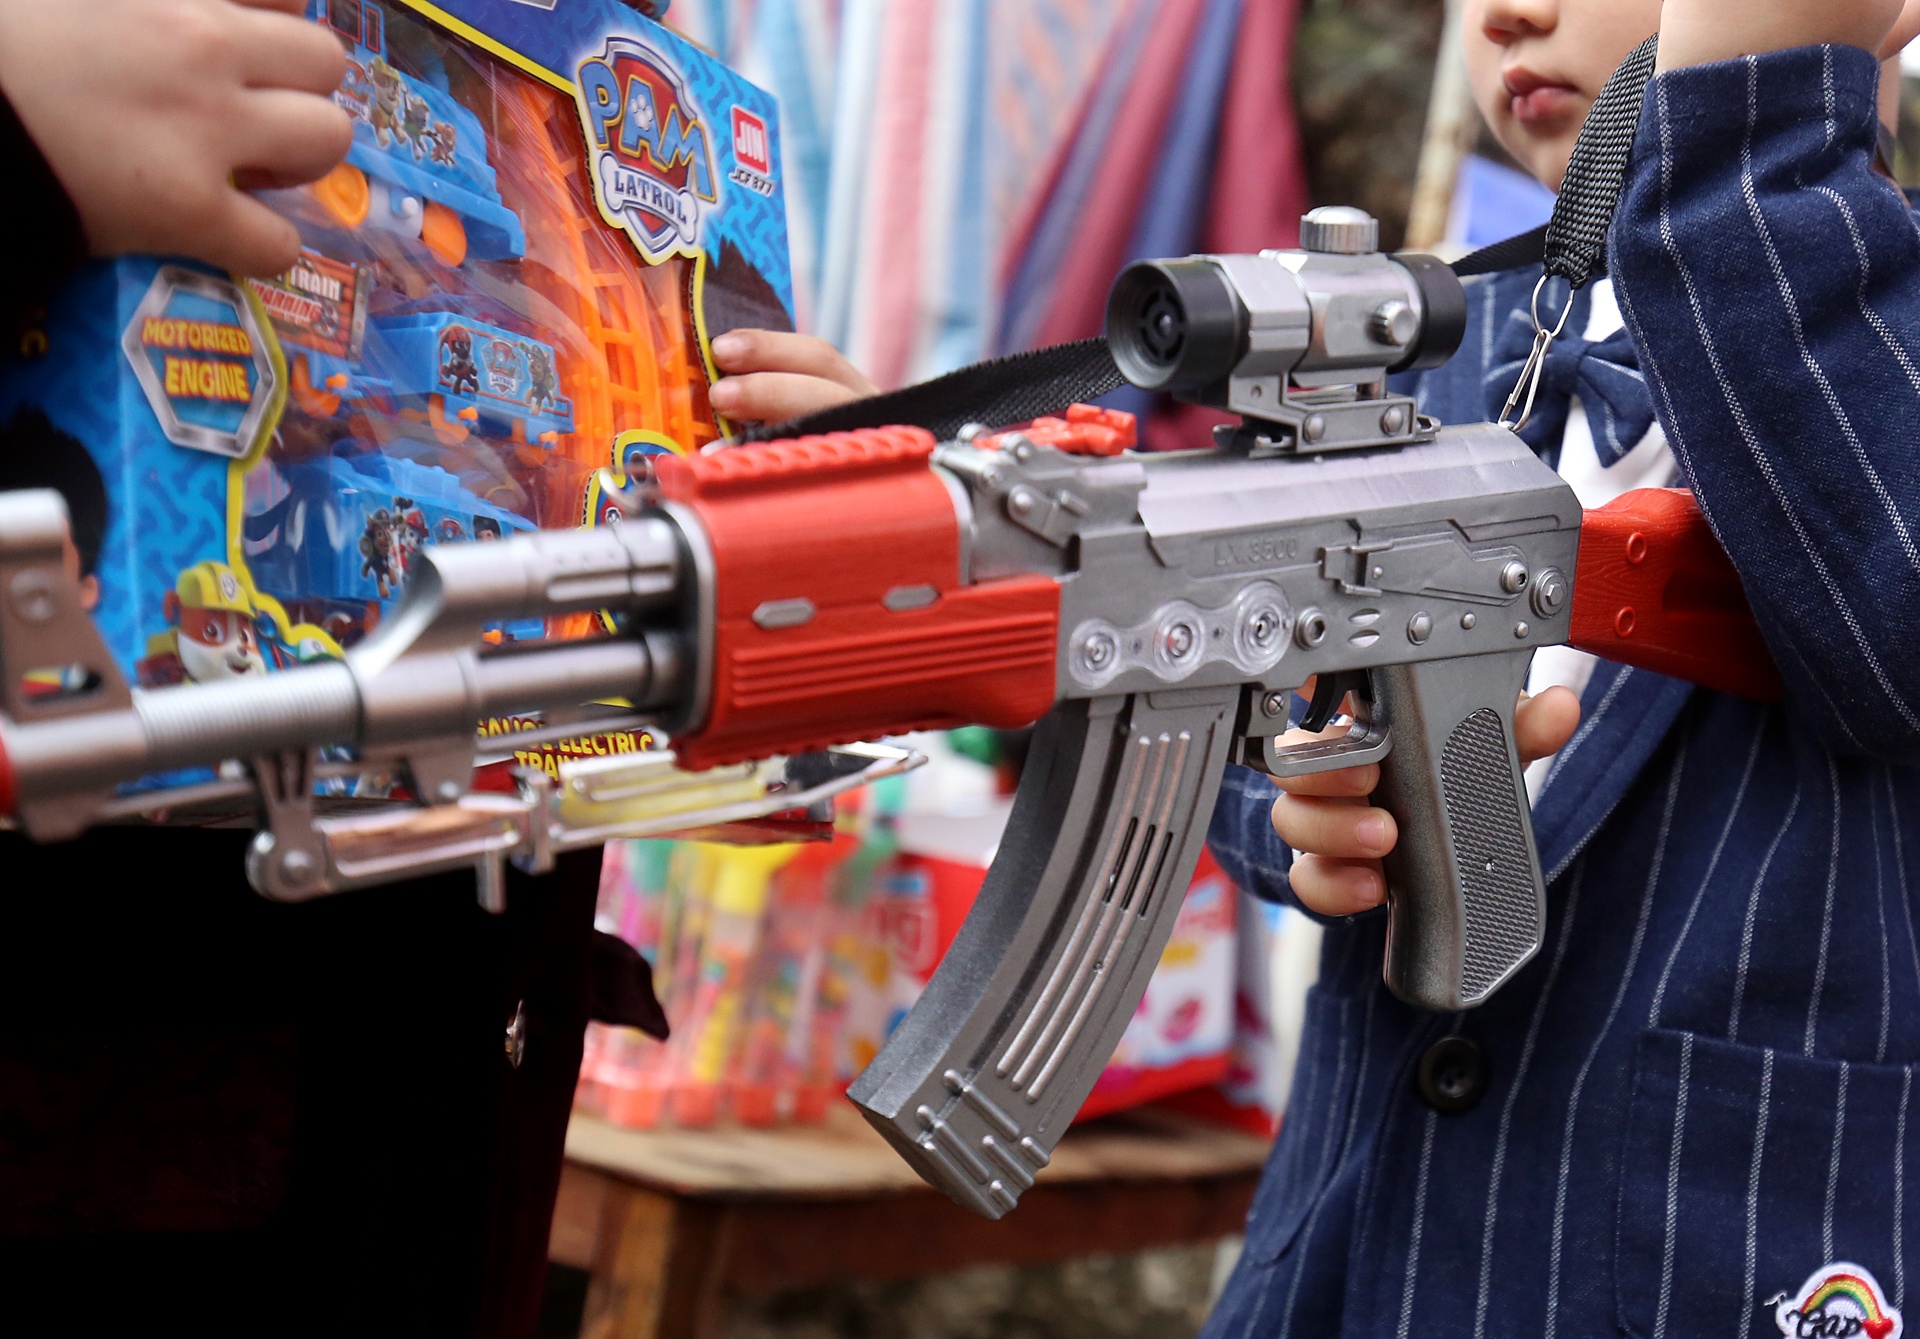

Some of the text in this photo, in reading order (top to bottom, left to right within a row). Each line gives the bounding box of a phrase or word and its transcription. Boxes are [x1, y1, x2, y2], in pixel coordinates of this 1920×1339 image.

[577, 57, 717, 203] PAM
[736, 120, 766, 163] JIN
[614, 170, 687, 224] LATROL
[142, 317, 253, 357] MOTORIZED
[164, 355, 252, 403] ENGINE
